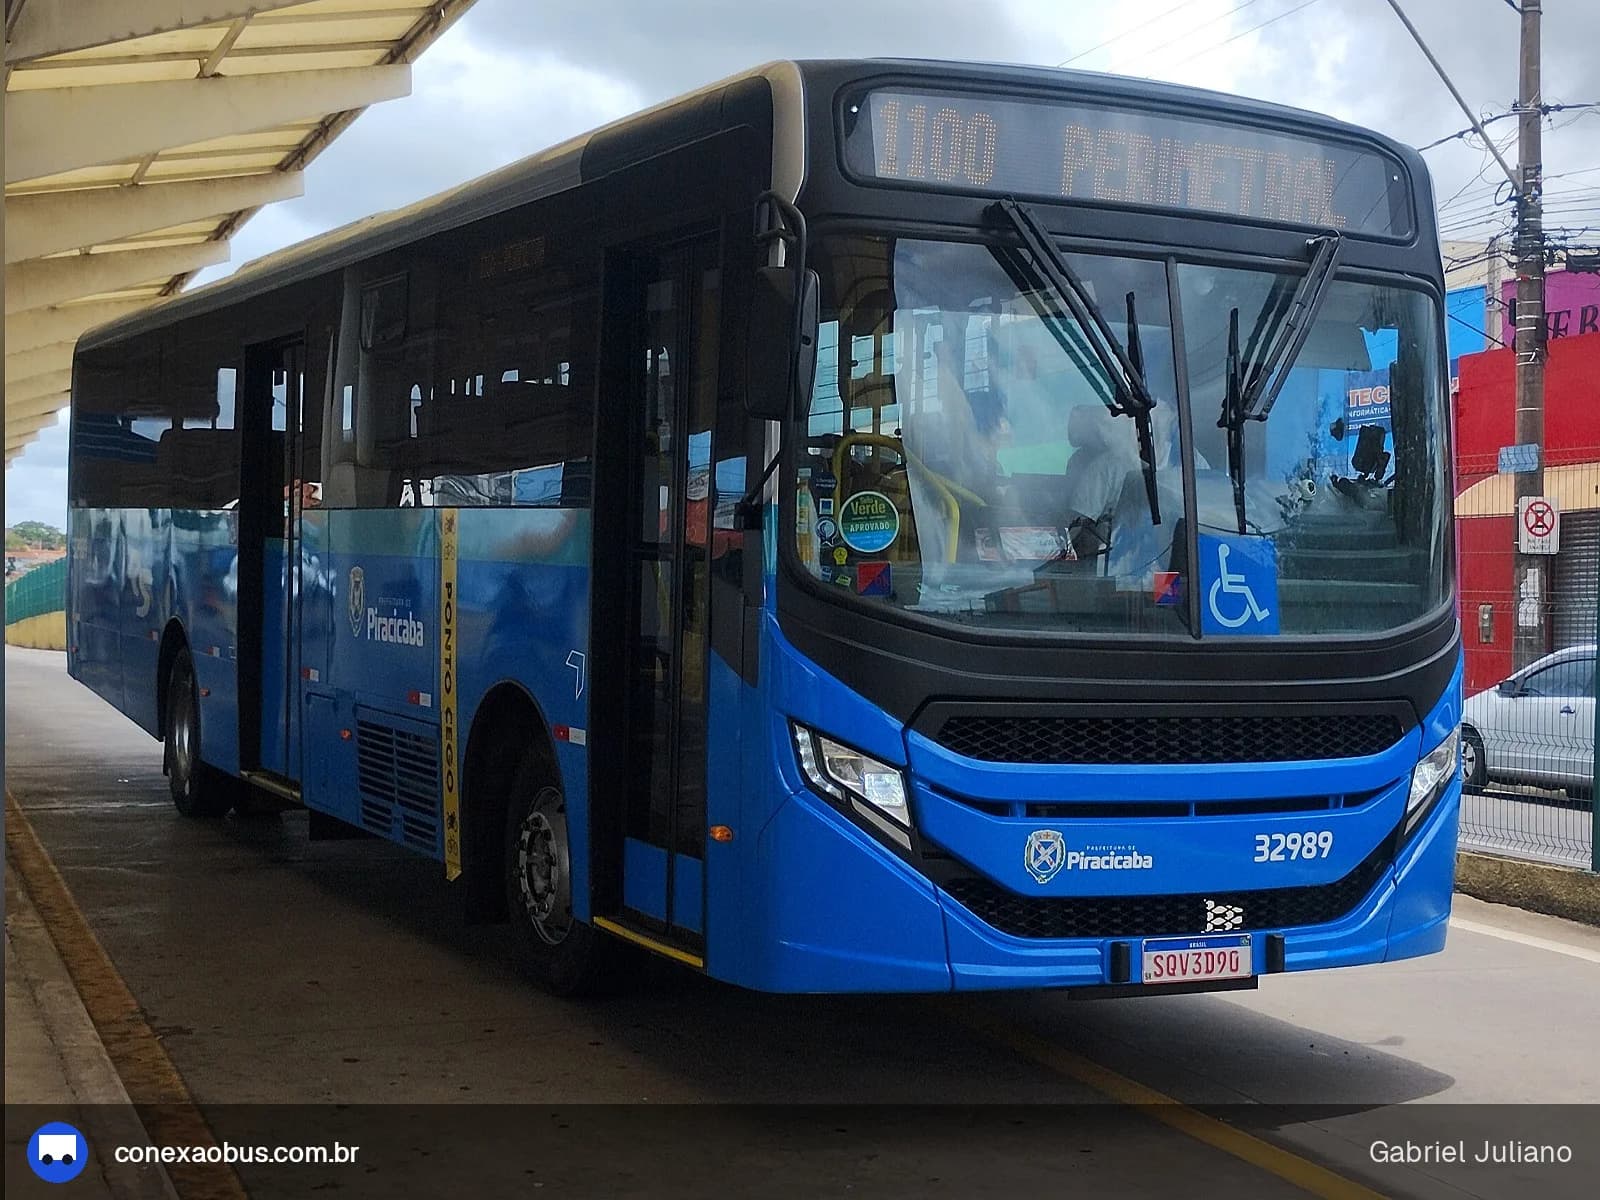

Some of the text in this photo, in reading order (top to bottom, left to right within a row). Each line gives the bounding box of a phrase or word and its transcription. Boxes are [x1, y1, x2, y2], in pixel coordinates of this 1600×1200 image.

[879, 100, 1347, 229] 1100 PERIMETRAL
[850, 499, 886, 515] Verde
[850, 521, 890, 533] APROVADO
[367, 607, 424, 647] Piracicaba
[444, 582, 454, 793] PONTO CEGO
[1067, 850, 1153, 870] Piracicaba
[1254, 831, 1334, 863] 32989
